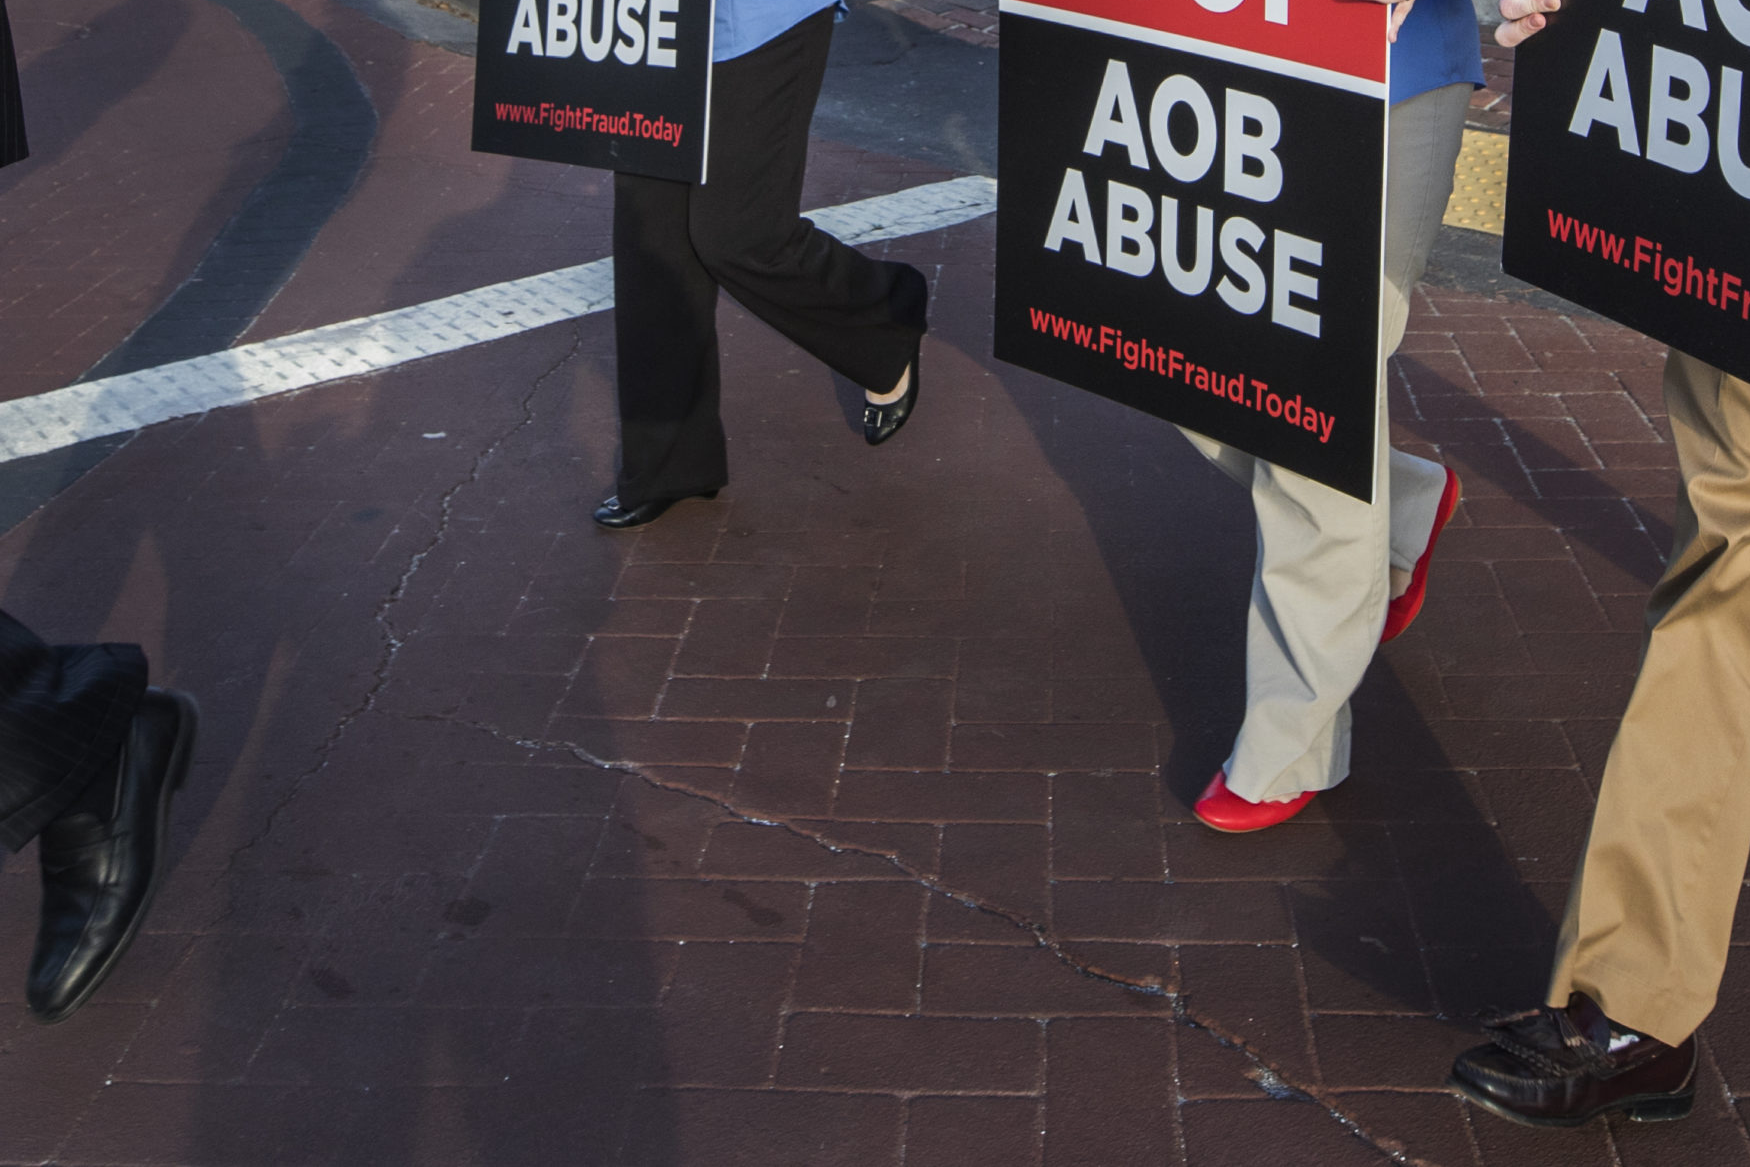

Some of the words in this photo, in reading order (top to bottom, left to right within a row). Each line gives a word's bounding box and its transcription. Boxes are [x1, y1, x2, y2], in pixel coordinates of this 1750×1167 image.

[495, 102, 684, 148] www.FightFraud.Today
[1083, 58, 1284, 203] AOB
[1043, 167, 1323, 339] ABUSE
[1029, 307, 1336, 444] www.FightFraud.Today
